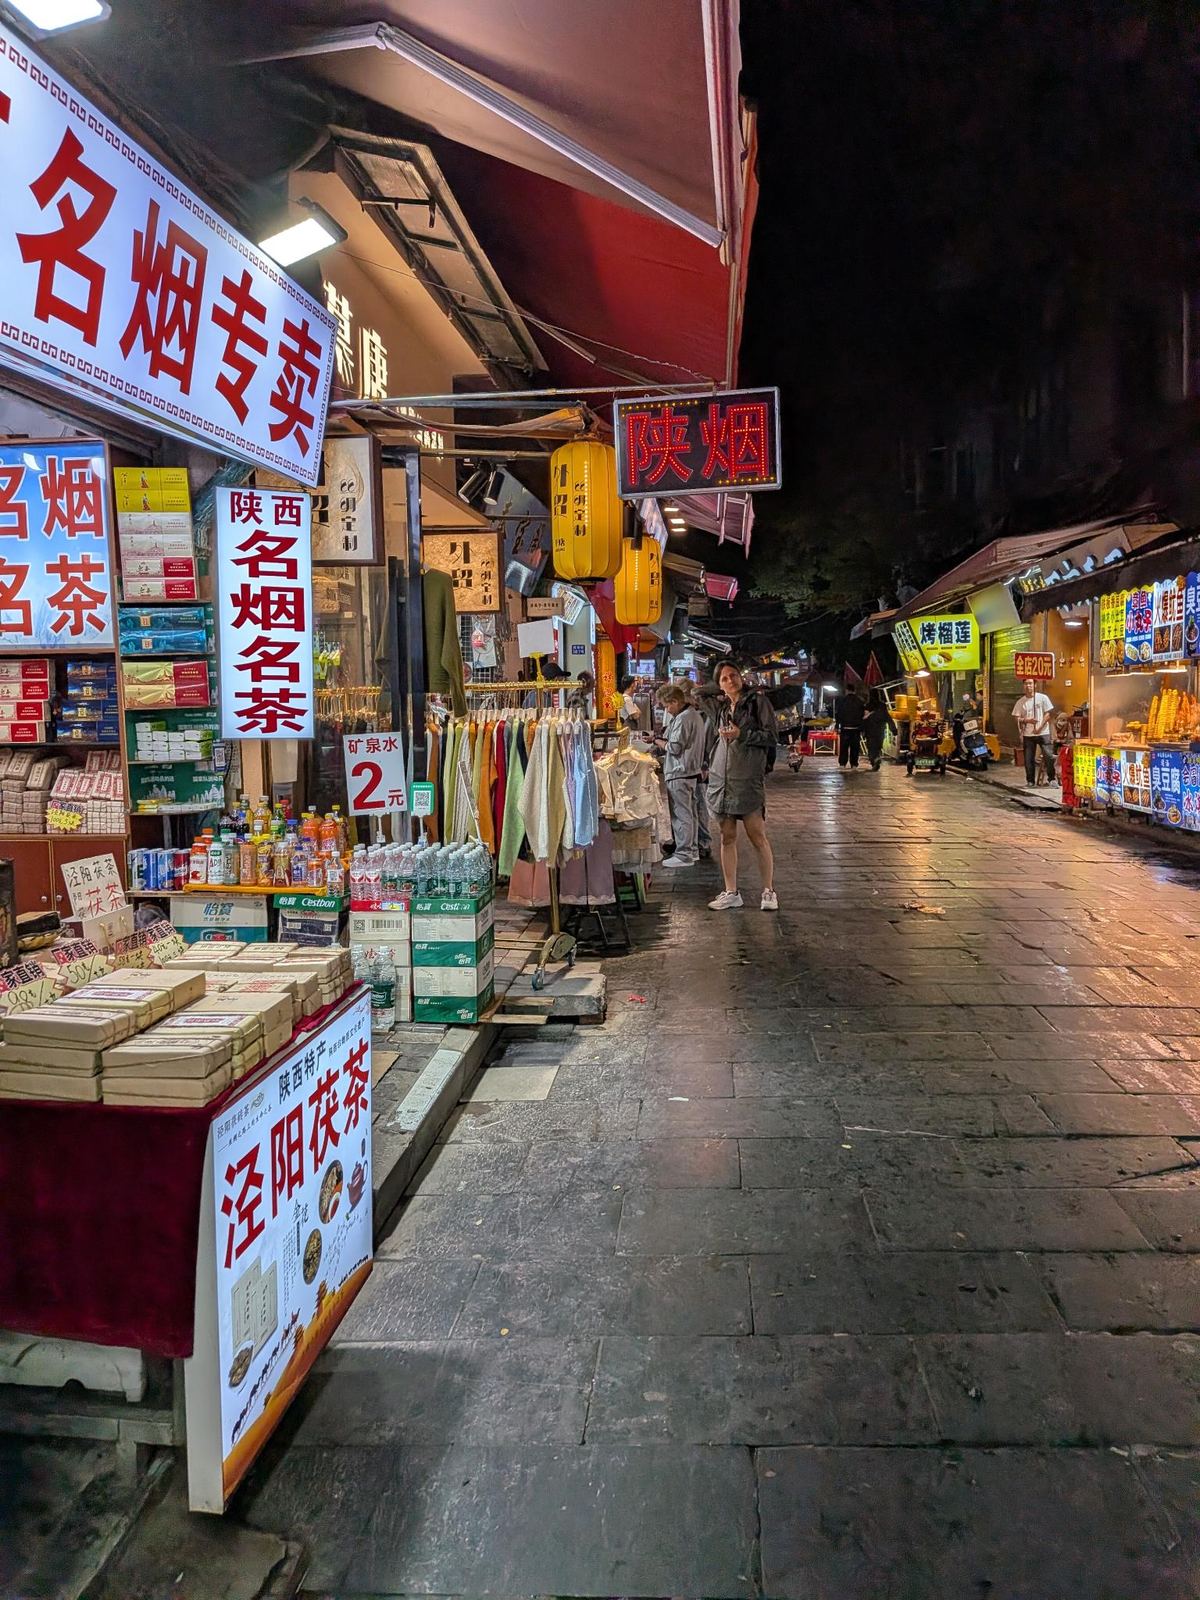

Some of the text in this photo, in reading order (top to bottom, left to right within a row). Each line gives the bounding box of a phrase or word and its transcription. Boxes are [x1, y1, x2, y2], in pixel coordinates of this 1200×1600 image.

[0, 92, 322, 457] 名烟专卖
[626, 404, 769, 486] 陕烟
[230, 491, 304, 527] 陕西
[230, 530, 309, 734] 名烟名茶
[920, 620, 971, 645] 烤榴莲
[1016, 655, 1052, 676] 全店20元
[348, 737, 398, 754] 矿泉水
[352, 761, 404, 810] 2 元
[1152, 765, 1181, 794] 臭豆腐
[278, 1040, 326, 1105] 陕西特产
[220, 1037, 370, 1269] 泾阳茯茶
